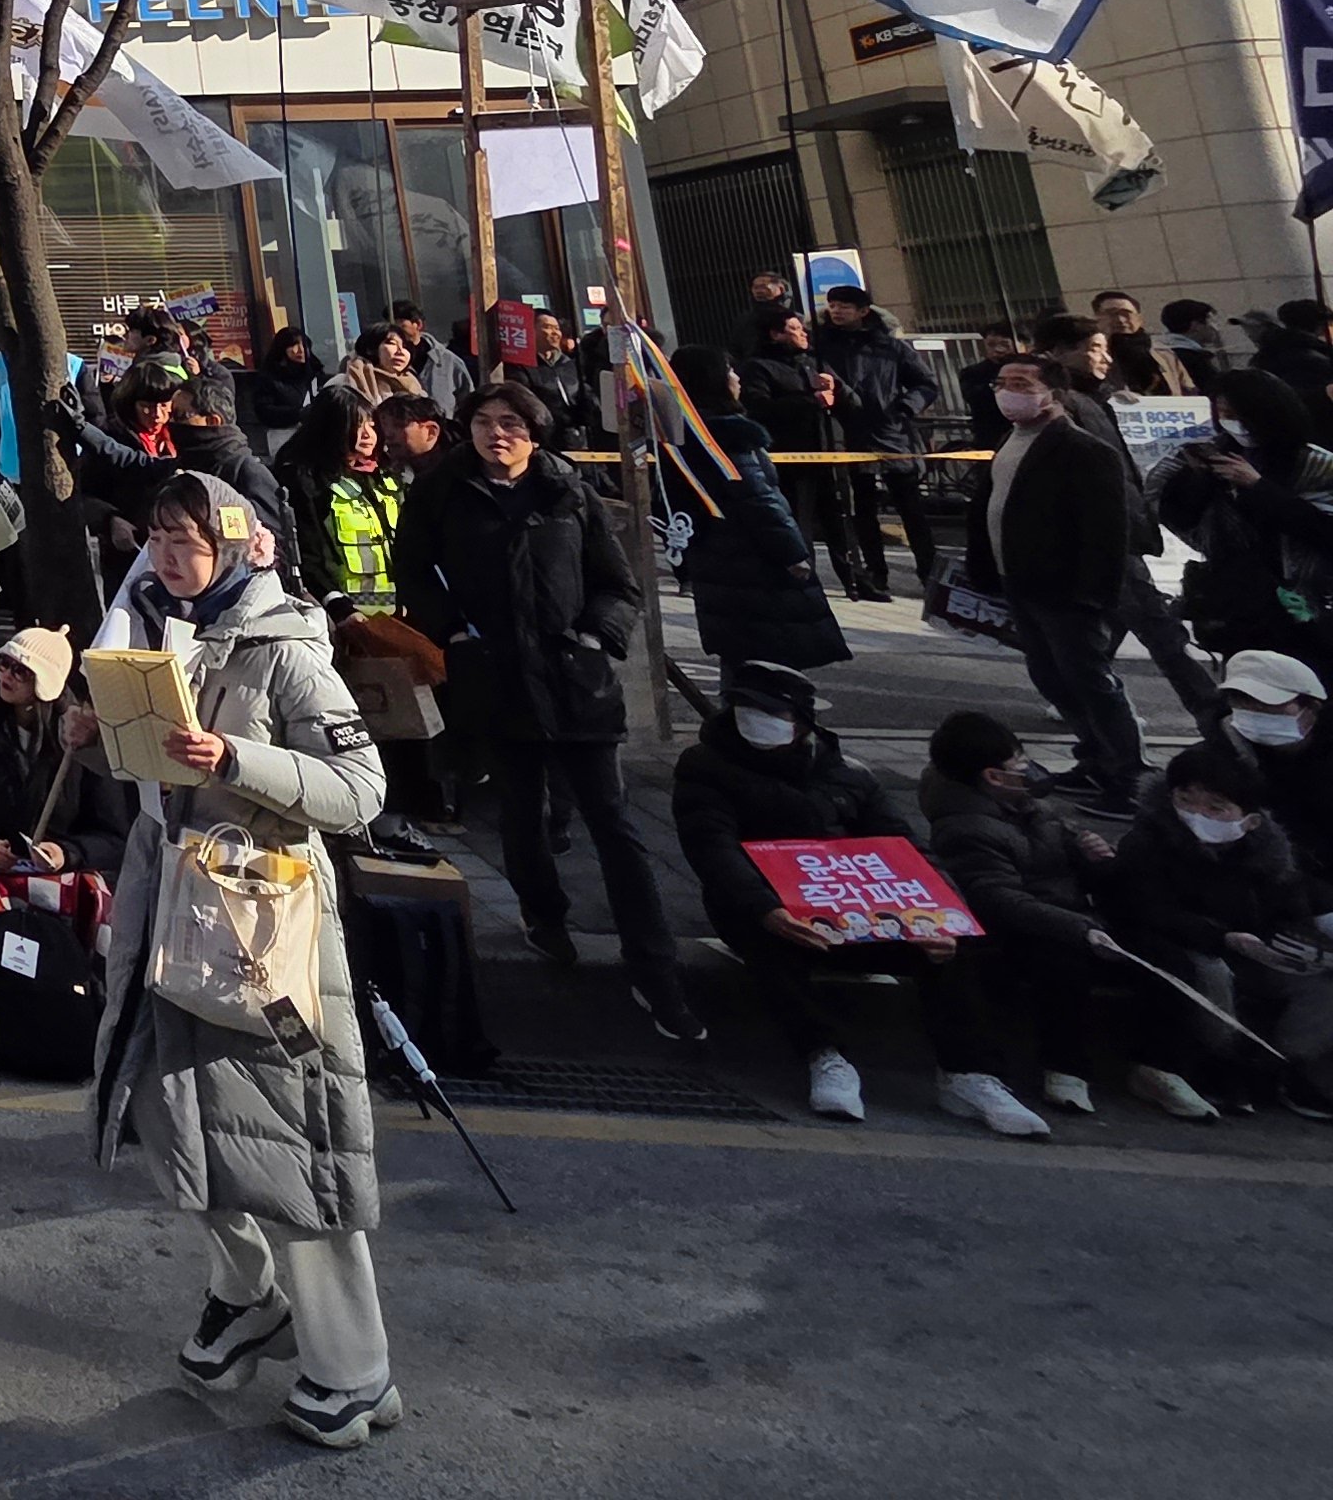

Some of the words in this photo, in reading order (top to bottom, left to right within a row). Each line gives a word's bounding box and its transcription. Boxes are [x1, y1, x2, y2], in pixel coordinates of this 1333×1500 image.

[796, 852, 898, 882] 윤석열
[798, 881, 872, 914] 즉각
[861, 878, 939, 910] 파면
